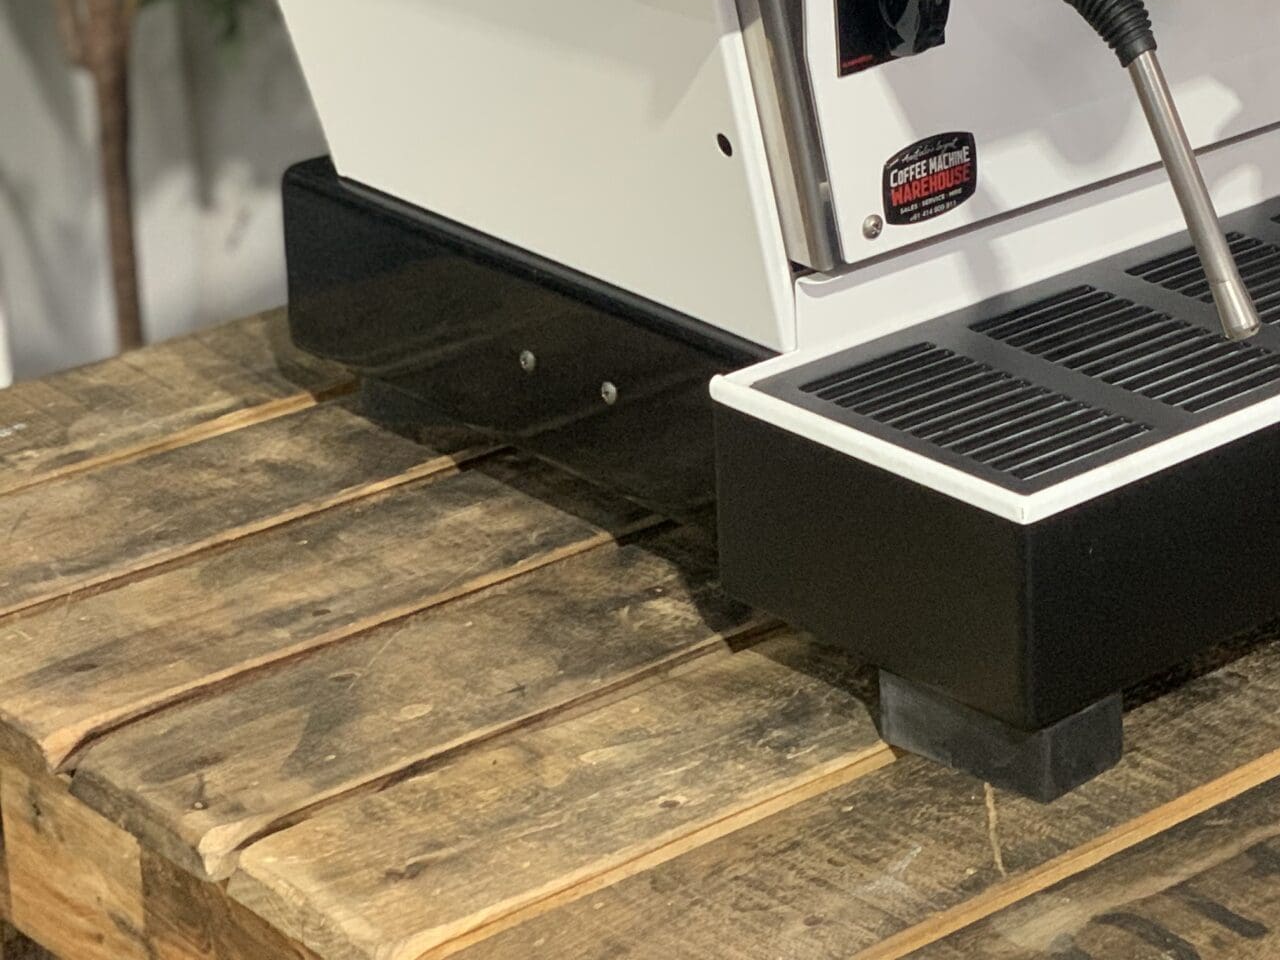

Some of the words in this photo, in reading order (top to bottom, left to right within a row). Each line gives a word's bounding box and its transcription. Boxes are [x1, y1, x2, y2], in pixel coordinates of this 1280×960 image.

[889, 159, 928, 188] COFFEE
[928, 146, 970, 175] MACHINE
[891, 162, 971, 207] WAREHOUSE
